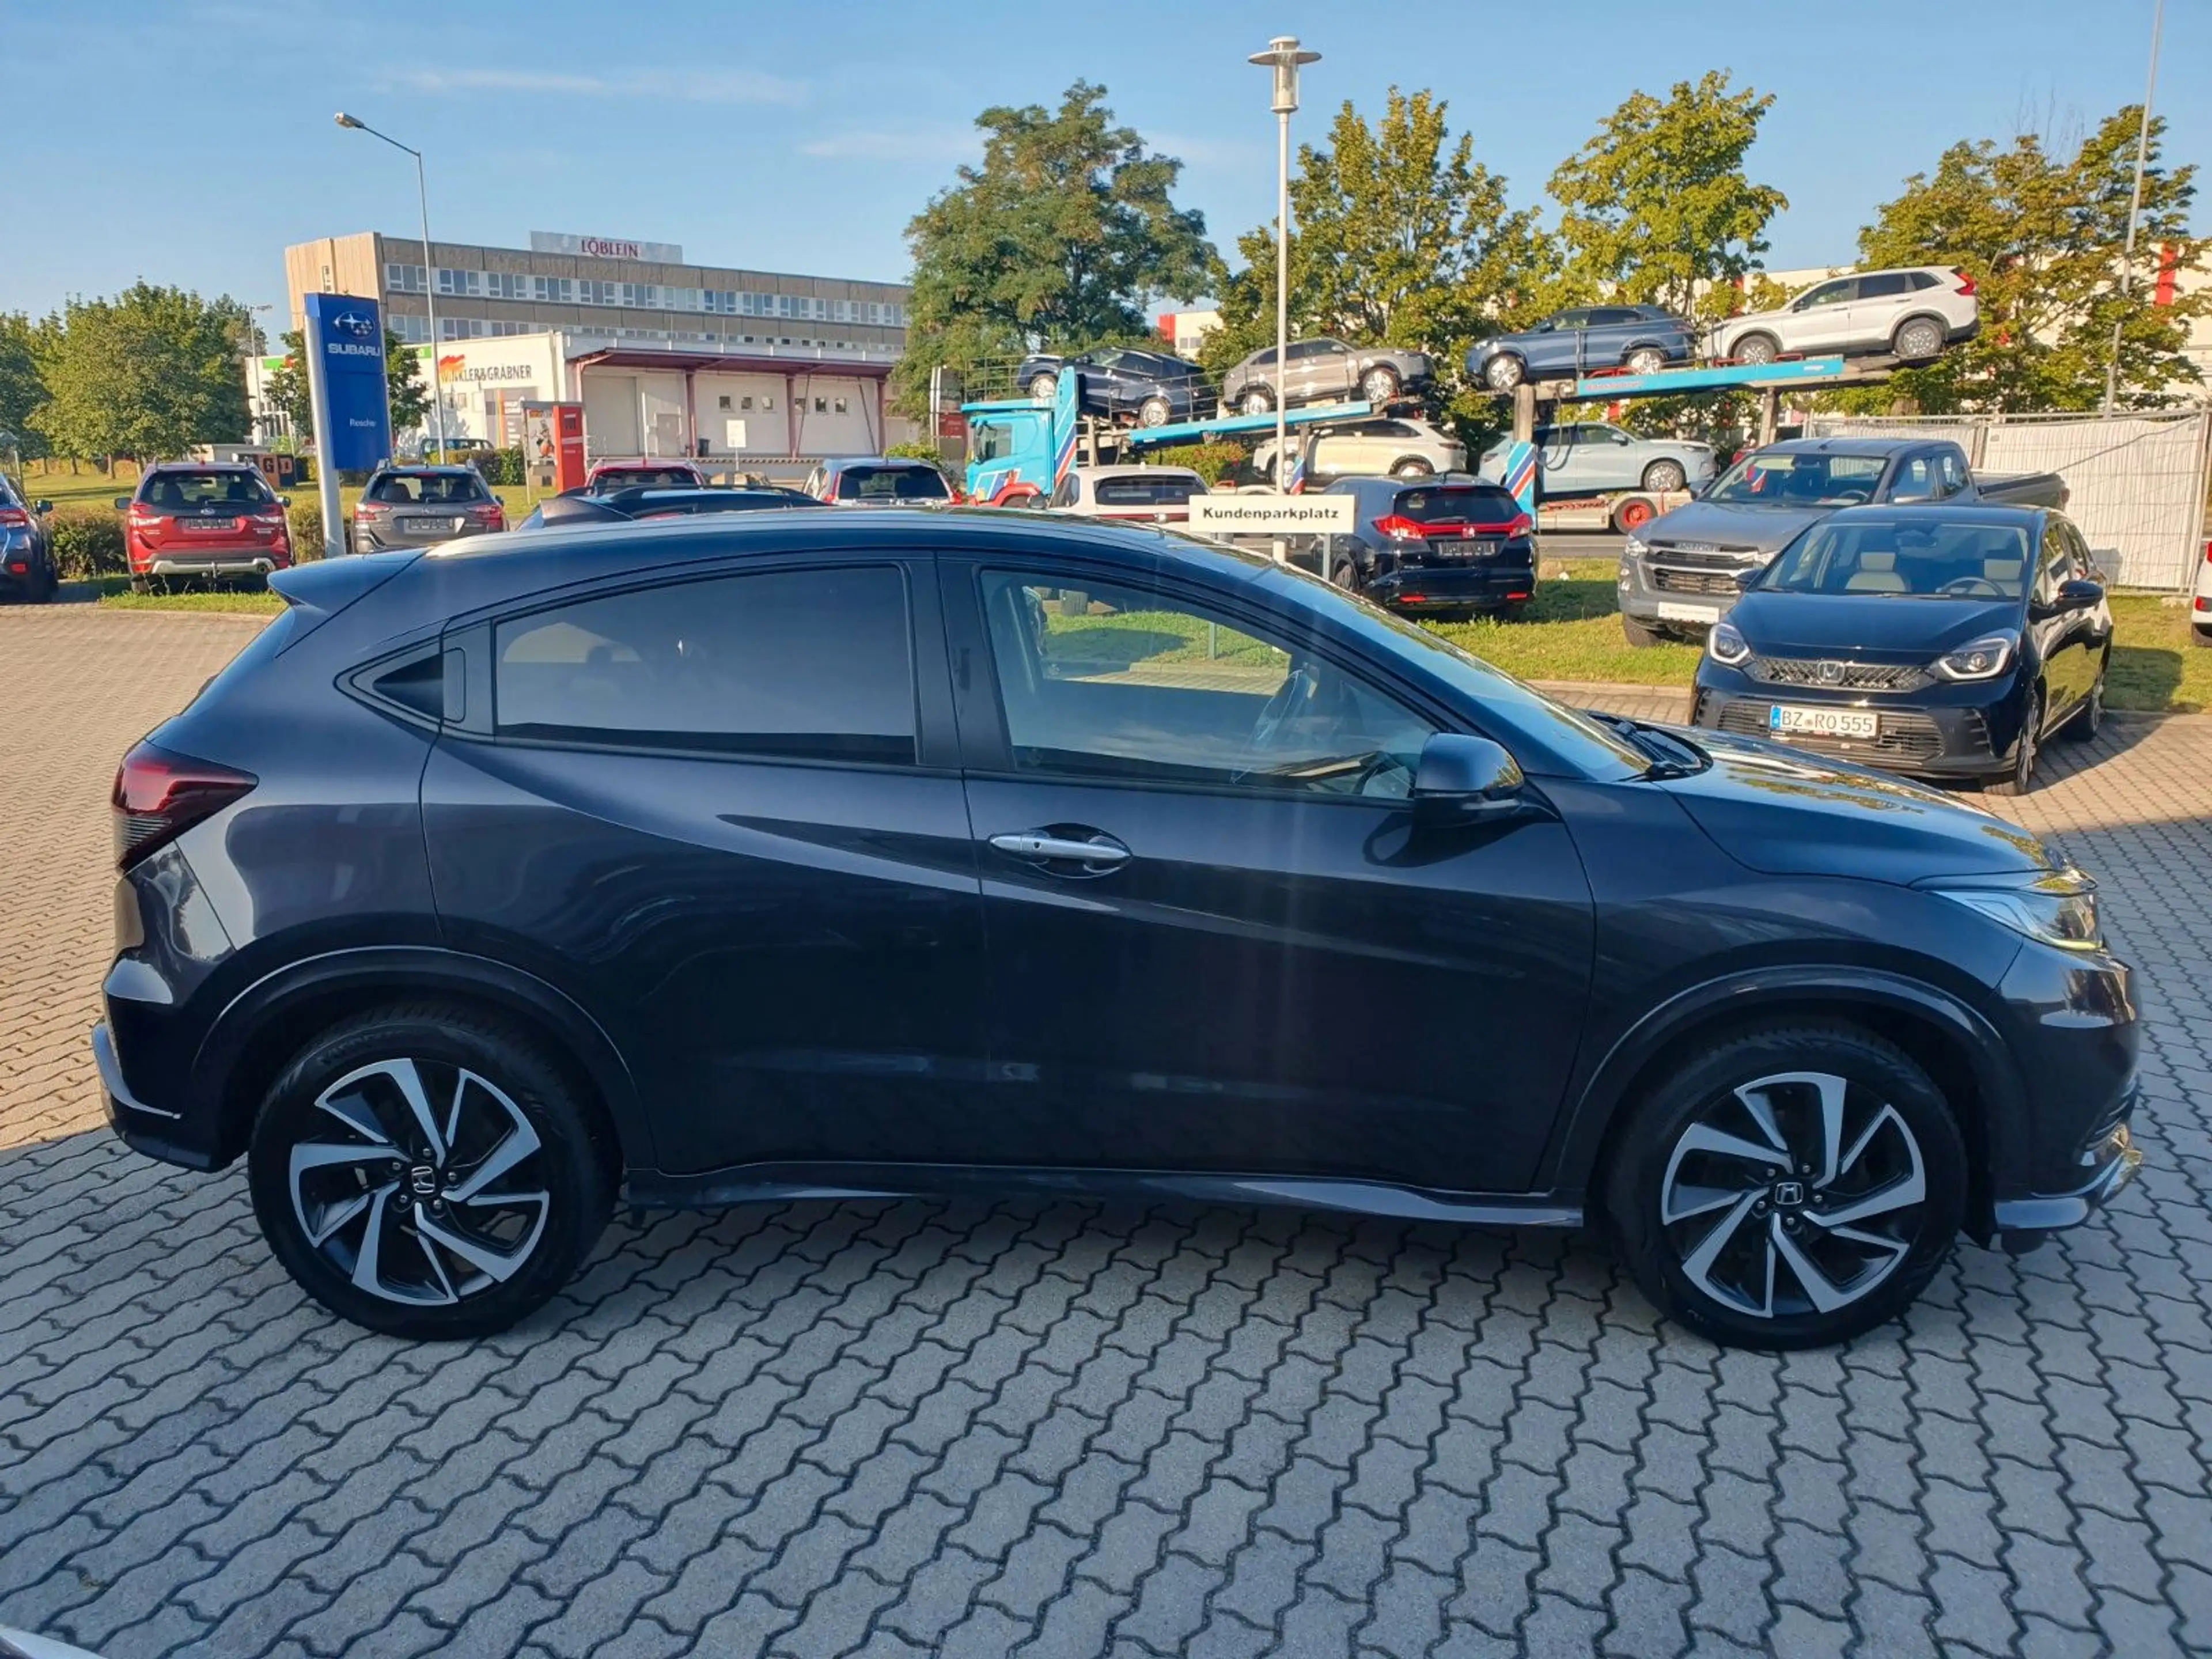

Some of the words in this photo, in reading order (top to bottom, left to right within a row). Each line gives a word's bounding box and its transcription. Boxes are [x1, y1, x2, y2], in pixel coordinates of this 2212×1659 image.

[581, 237, 638, 257] LÖBLEIN
[328, 343, 381, 356] SUBARU
[1203, 507, 1339, 521] Kundenparkplatz
[1782, 711, 1803, 727] BZ
[1840, 715, 1873, 733] 555
